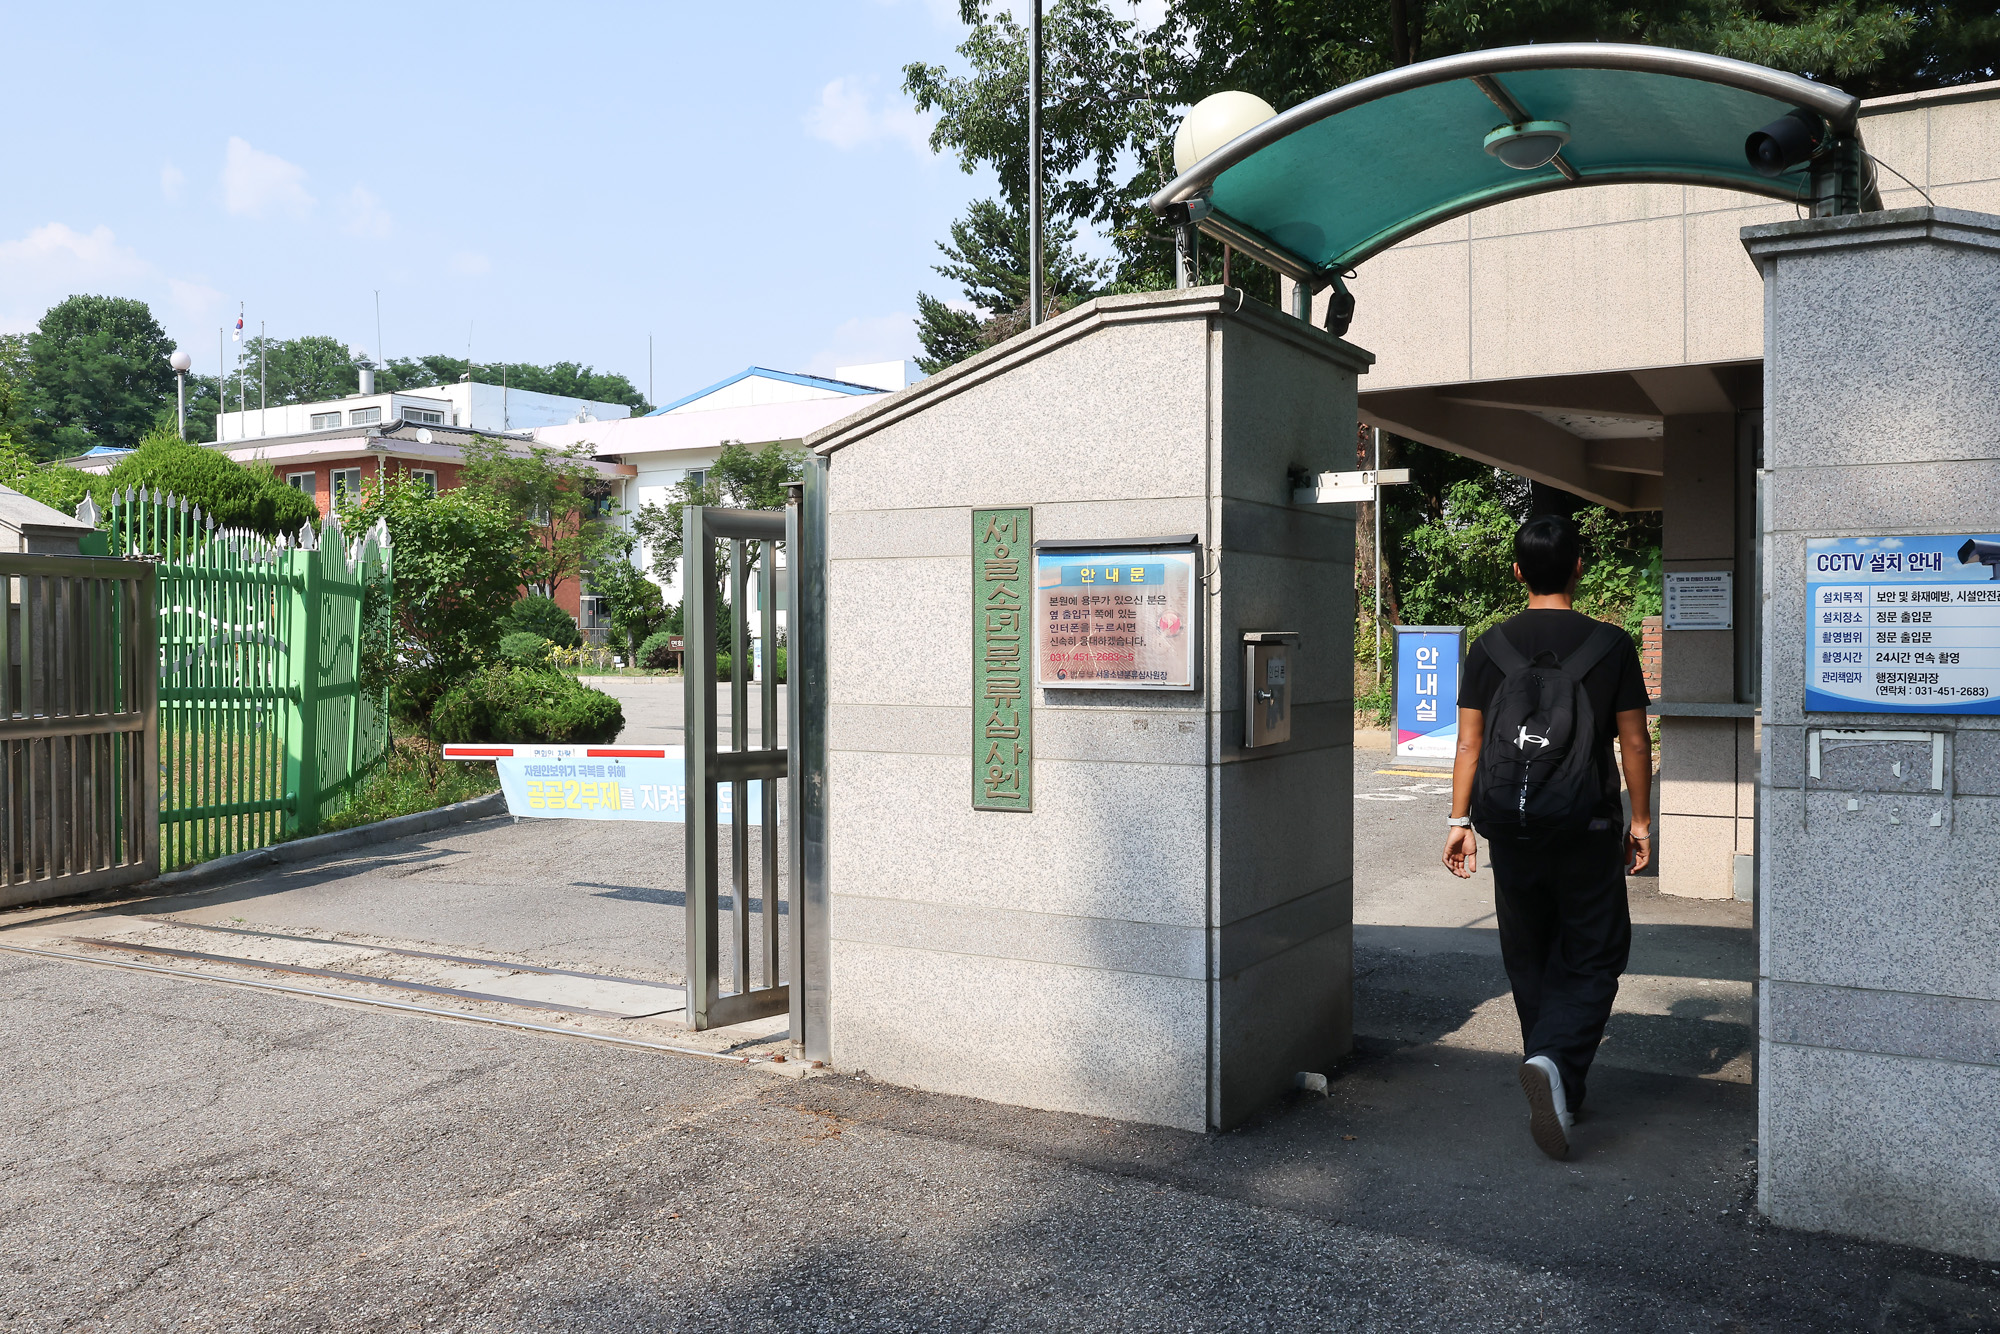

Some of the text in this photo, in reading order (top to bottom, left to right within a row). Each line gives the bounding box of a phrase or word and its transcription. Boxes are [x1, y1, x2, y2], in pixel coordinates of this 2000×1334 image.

[1817, 552, 1943, 573] CCTV 설치 안내
[1049, 595, 1167, 606] 본원에 용무가 있으신 분은
[1823, 592, 1863, 603] 설치목적
[1877, 592, 1896, 603] 보안
[1899, 591, 1908, 603] 및
[1911, 591, 1953, 603] 화재예방,
[1050, 609, 1137, 620] 옆 출입구 쪽에 있는
[1823, 612, 1863, 623] 설치장소
[1876, 611, 1932, 623] 정문 출입문
[1050, 623, 1136, 634] 인터폰을 누르시면
[1050, 637, 1076, 647] 신속히
[1823, 632, 1862, 643] 촬영범위
[1876, 631, 1932, 643] 정문 출입문
[983, 515, 1023, 800] 서울소년분류심사원
[1050, 652, 1134, 662] 031) 451-2683~5
[1822, 652, 1862, 663] 촬영시간
[1876, 652, 1960, 663] 24시간 연속 촬영
[1096, 670, 1168, 680] 서울소년분류심사원장
[1822, 672, 1862, 683] 관리책임자
[1876, 672, 1939, 684] 행정지원과장
[1415, 647, 1439, 722] 안내실
[1876, 686, 1907, 697] (연락처
[1915, 686, 1989, 697] 031-451-2683)
[524, 765, 626, 778] 자원안보위기 극복을 위해
[527, 779, 733, 813] 공공2부제를 지켜요
